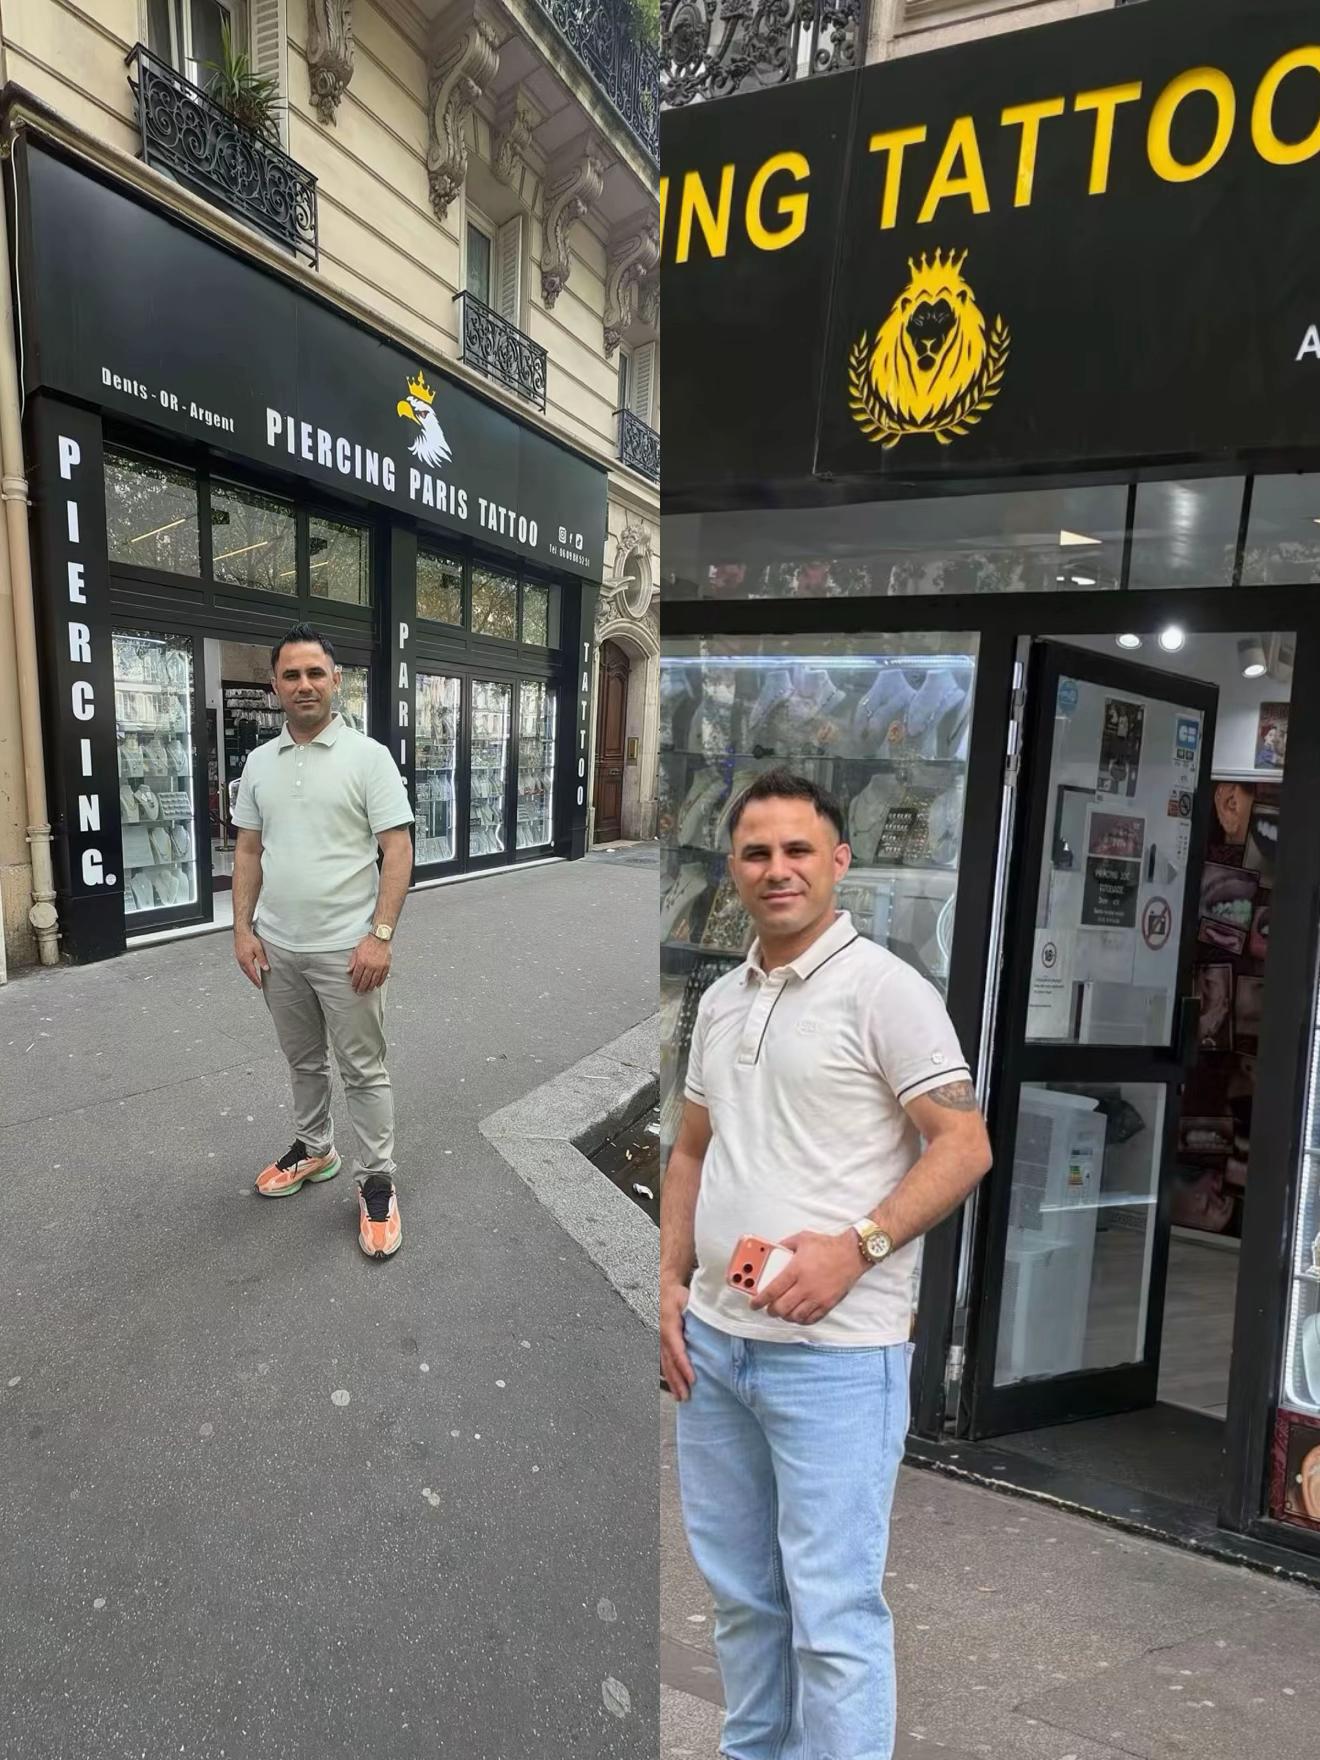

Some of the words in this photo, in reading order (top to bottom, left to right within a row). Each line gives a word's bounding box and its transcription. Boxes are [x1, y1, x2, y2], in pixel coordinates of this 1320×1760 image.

[869, 46, 1320, 229] TATTOO
[101, 366, 148, 400] Dents
[160, 389, 179, 412] OR
[190, 401, 235, 433] Argent
[266, 407, 396, 492] PIERCING
[410, 467, 468, 520] PARIS
[479, 497, 538, 547] TATTOO
[398, 622, 409, 785] PARI
[577, 642, 590, 806] TATTOO
